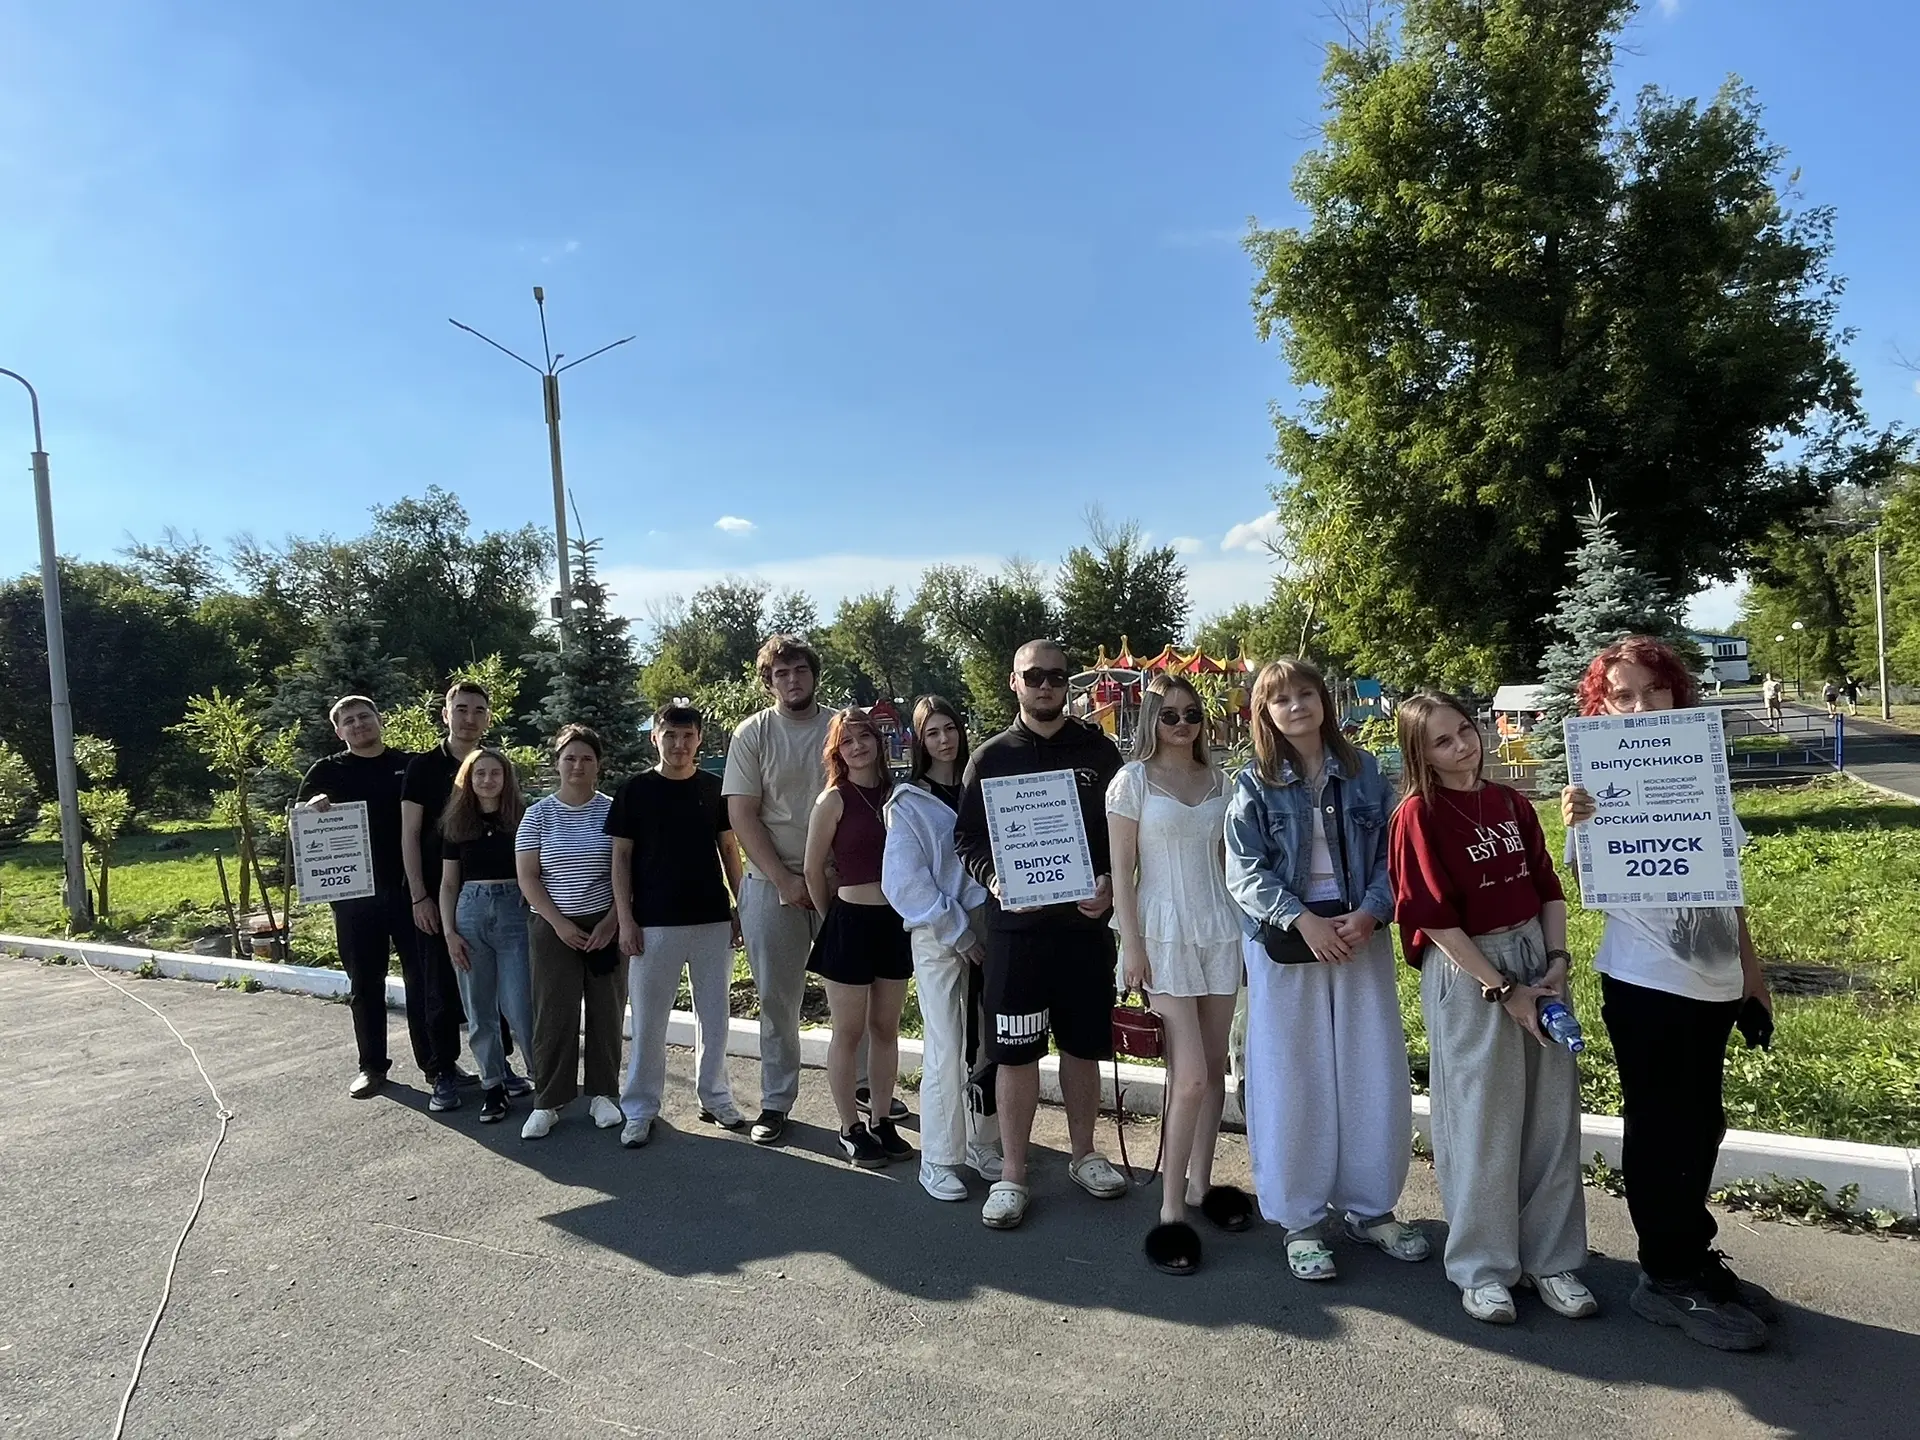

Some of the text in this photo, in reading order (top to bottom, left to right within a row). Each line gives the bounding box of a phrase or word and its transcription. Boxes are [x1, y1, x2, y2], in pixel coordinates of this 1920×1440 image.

[1618, 737, 1672, 750] Аллея
[1590, 754, 1704, 771] выпускников
[1015, 789, 1048, 800] Аллея
[1000, 800, 1067, 813] выпускников
[1599, 800, 1631, 808] МФЮА
[1594, 811, 1712, 826] ОРСКИЙ ФИЛИАЛ
[1474, 826, 1501, 842] LA
[1004, 836, 1075, 851] ОРСКИЙ ФИЛИАЛ
[1465, 840, 1498, 862] EST
[1607, 837, 1704, 855] ВЫПУСК
[304, 854, 333, 863] ОРСКИЙ
[1014, 853, 1072, 870] ВЫПУСК
[311, 864, 358, 877] ВЫПУСК
[1625, 857, 1690, 877] 2026
[320, 875, 351, 888] 2026
[1025, 869, 1065, 885] 2026
